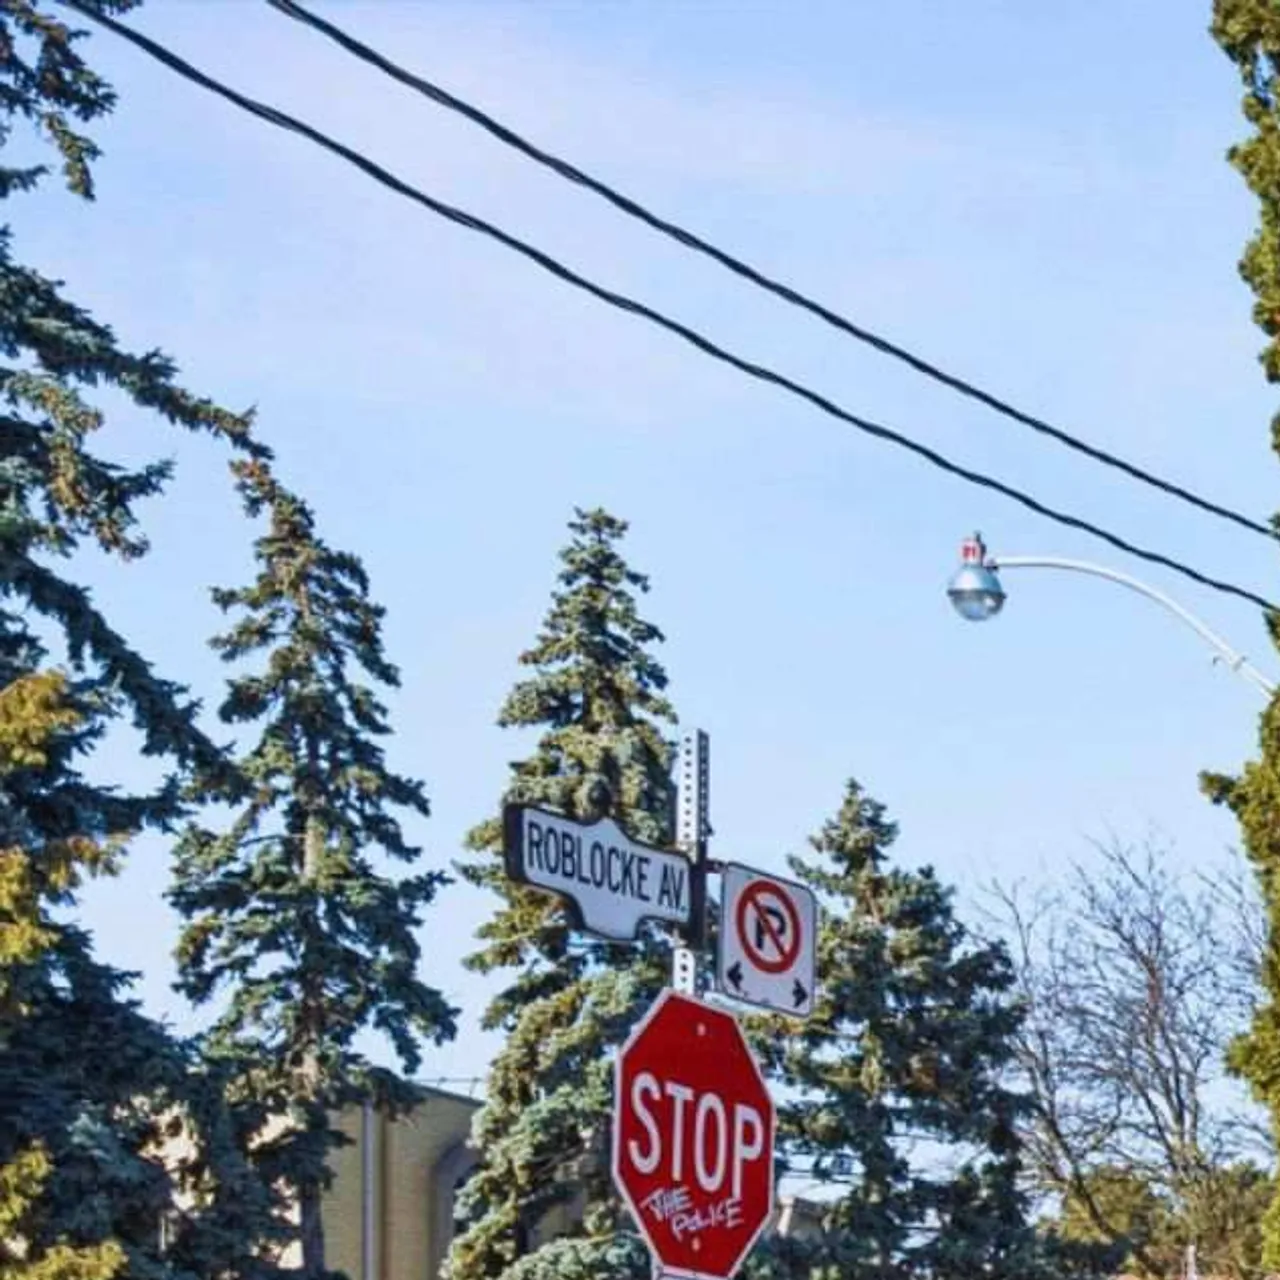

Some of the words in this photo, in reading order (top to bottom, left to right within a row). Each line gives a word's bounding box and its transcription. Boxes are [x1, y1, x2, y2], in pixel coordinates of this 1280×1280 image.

[526, 821, 653, 902] ROBLOCKE
[657, 862, 687, 912] AV.
[628, 1071, 764, 1199] STOP
[639, 1185, 693, 1223] THE
